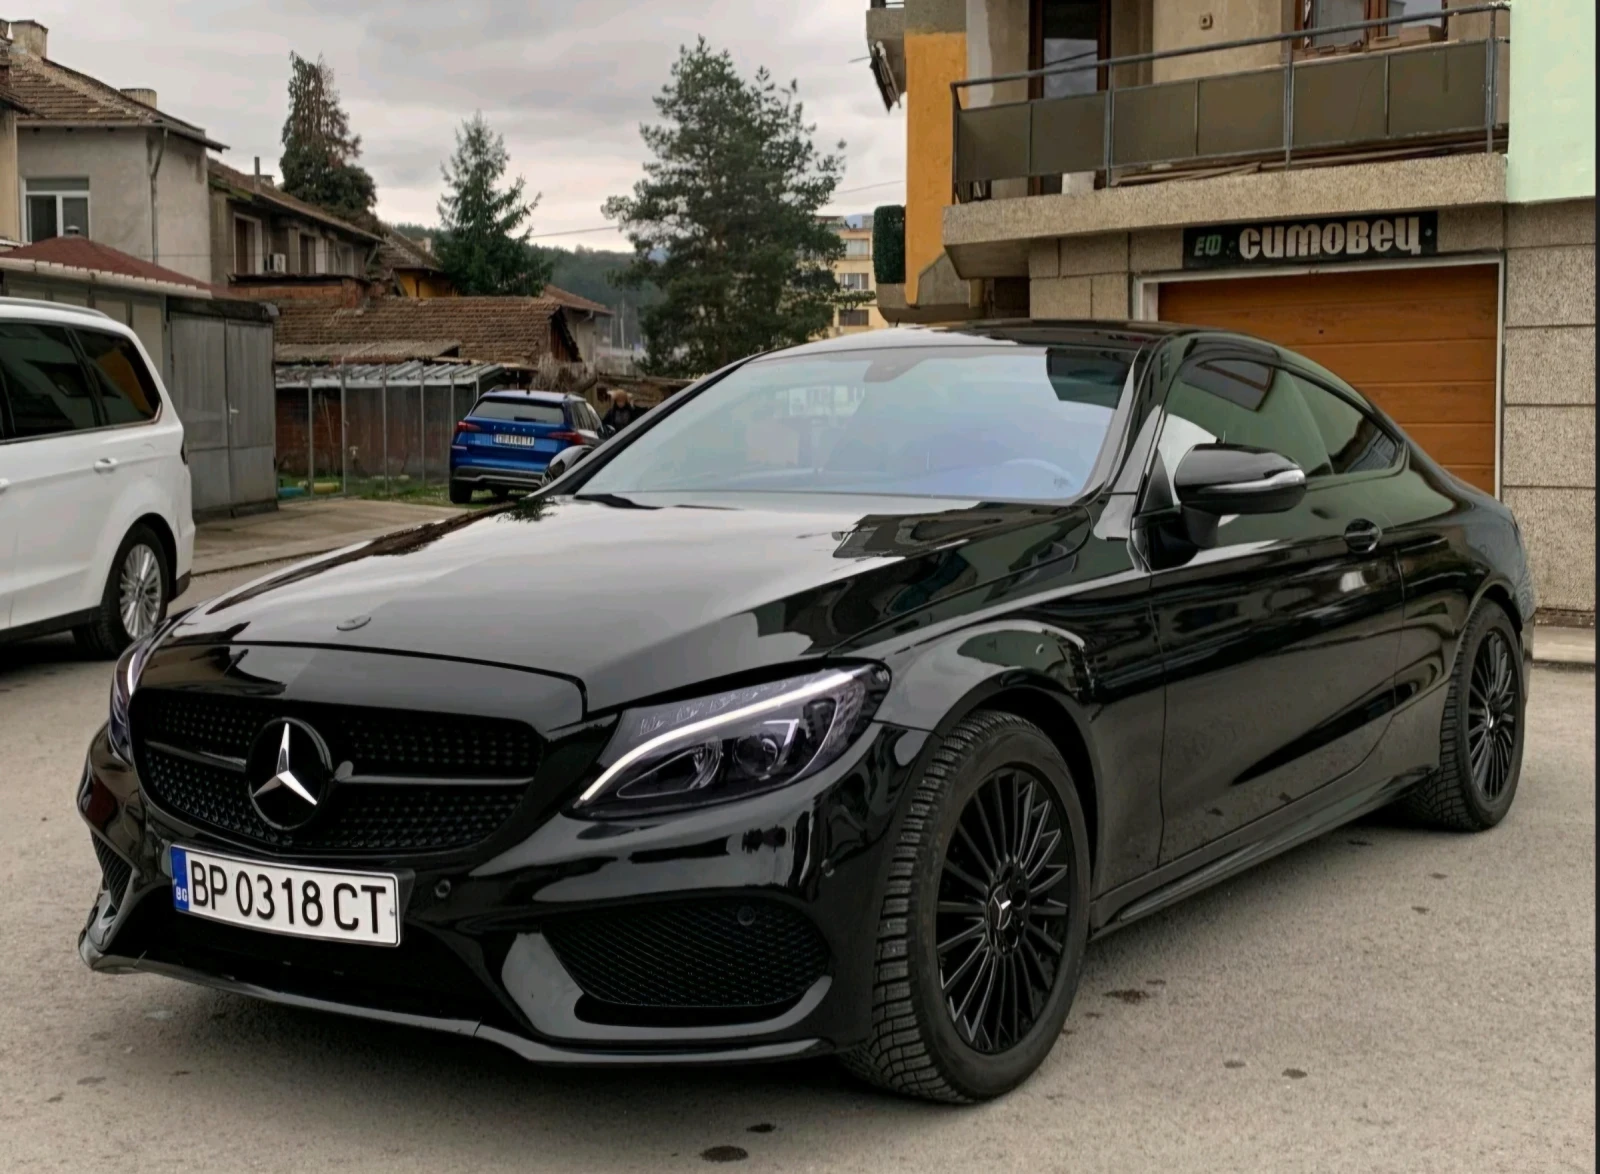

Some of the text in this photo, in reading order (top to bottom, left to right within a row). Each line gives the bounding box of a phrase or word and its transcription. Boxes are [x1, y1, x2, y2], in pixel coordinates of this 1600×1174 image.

[175, 887, 188, 902] BG
[190, 859, 387, 935] BP 0318 CT
